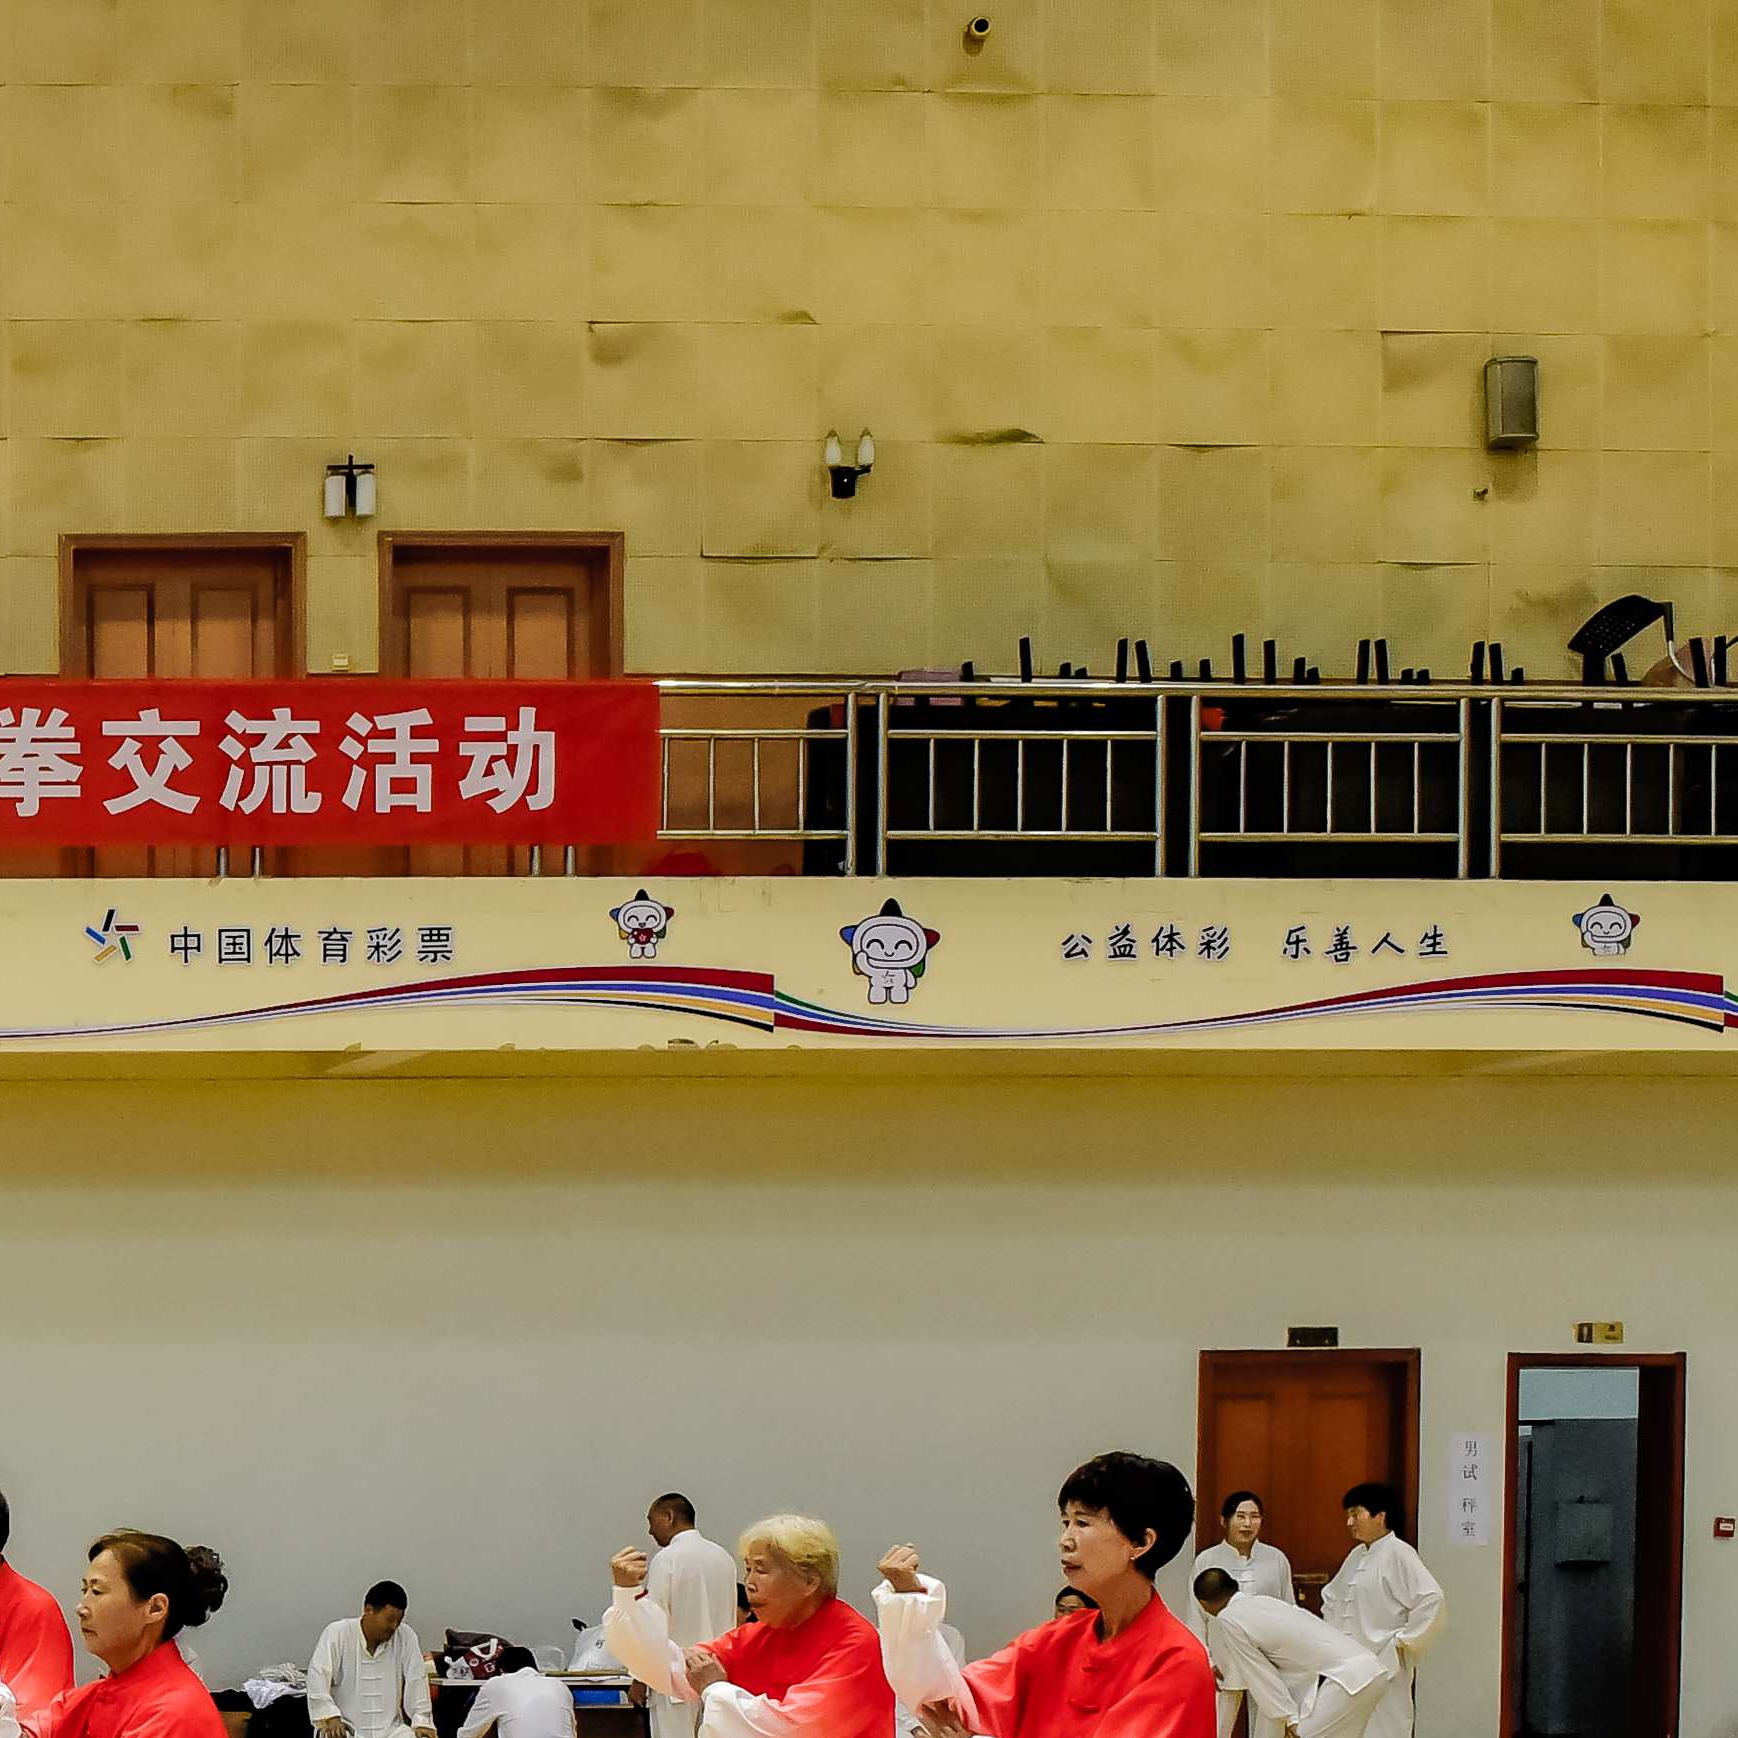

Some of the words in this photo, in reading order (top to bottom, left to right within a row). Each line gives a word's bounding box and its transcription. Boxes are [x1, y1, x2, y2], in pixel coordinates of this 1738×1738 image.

[169, 924, 455, 967] 中国体育彩票
[1061, 923, 1233, 962] 公益体彩
[1282, 924, 1451, 964] 乐善人生
